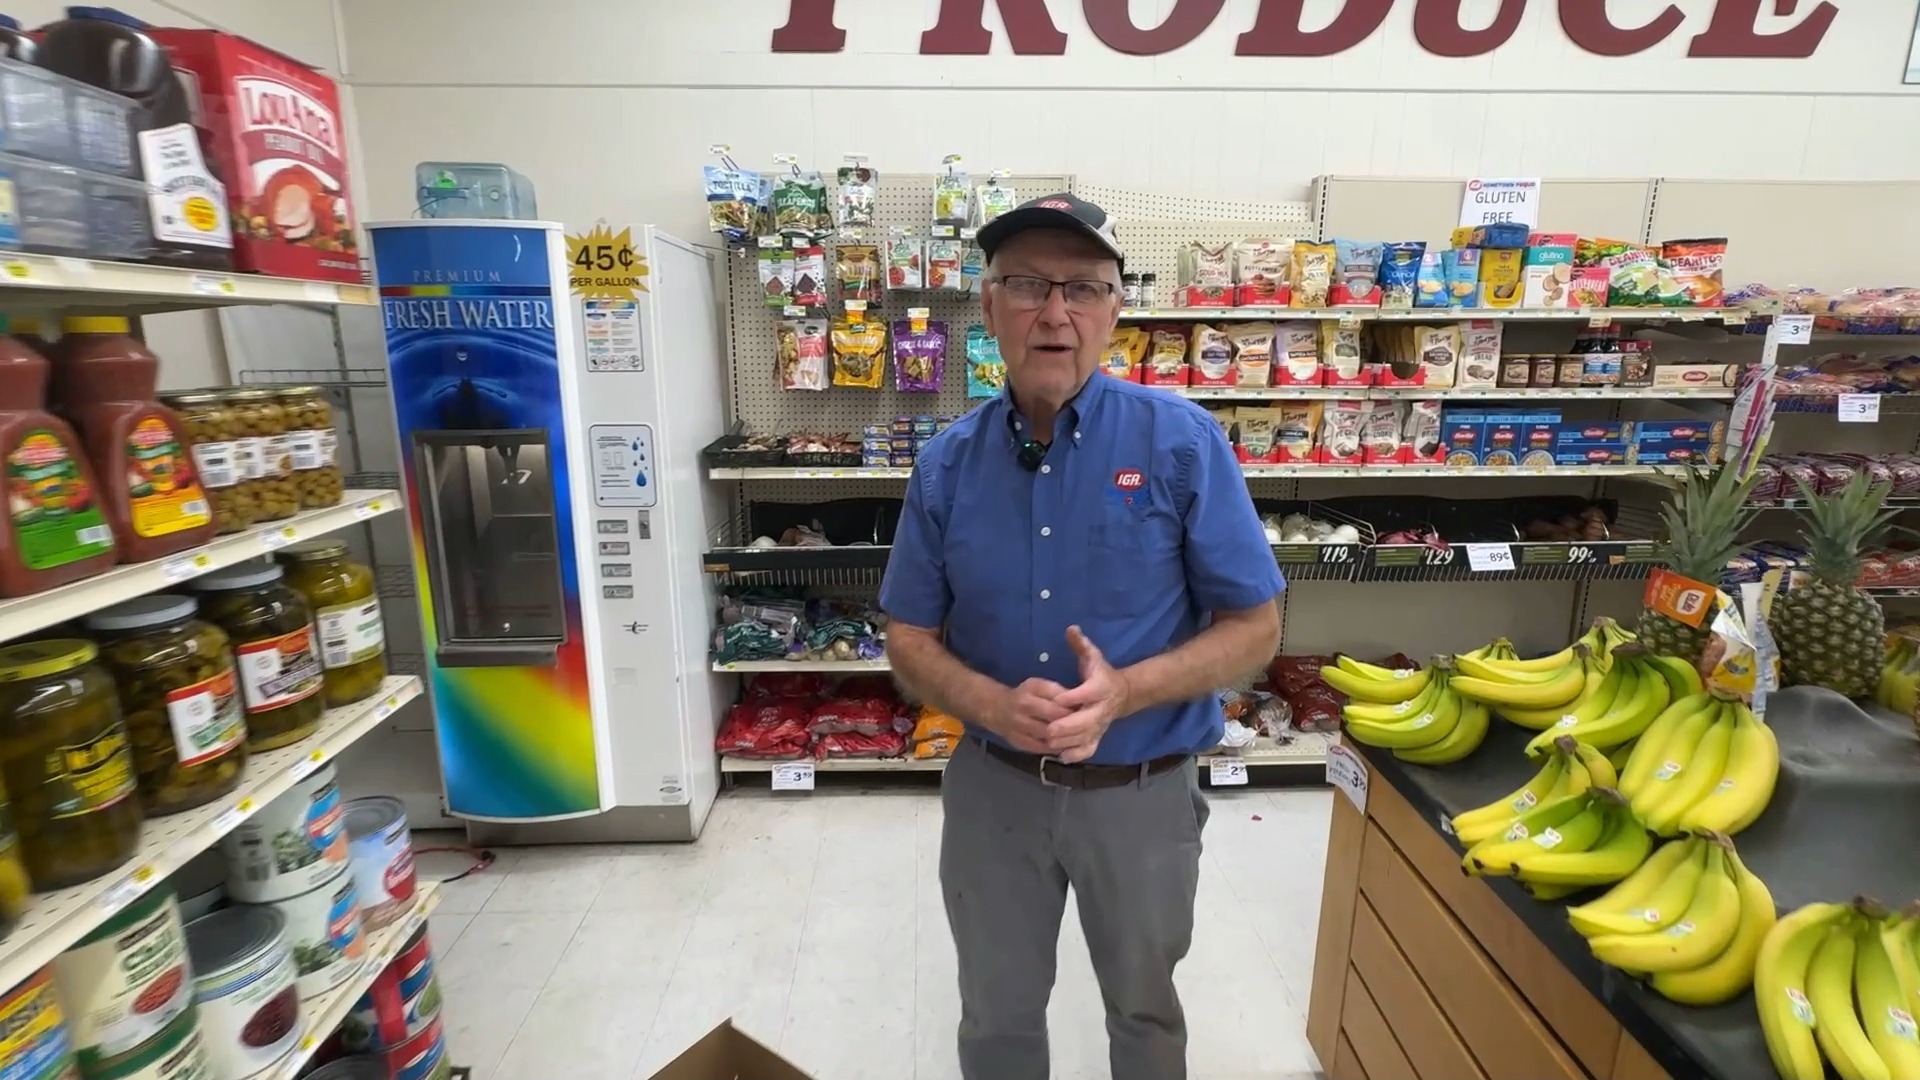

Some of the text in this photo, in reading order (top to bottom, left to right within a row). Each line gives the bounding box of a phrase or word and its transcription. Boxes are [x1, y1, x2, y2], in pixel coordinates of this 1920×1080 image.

[1475, 191, 1526, 204] GLUTEN
[1482, 211, 1513, 224] FREE
[576, 244, 633, 271] 45¢
[413, 269, 501, 282] PREMIUM
[570, 277, 639, 287] PER GALLON
[385, 300, 553, 329] FRESH WATER
[1118, 474, 1141, 485] IGA
